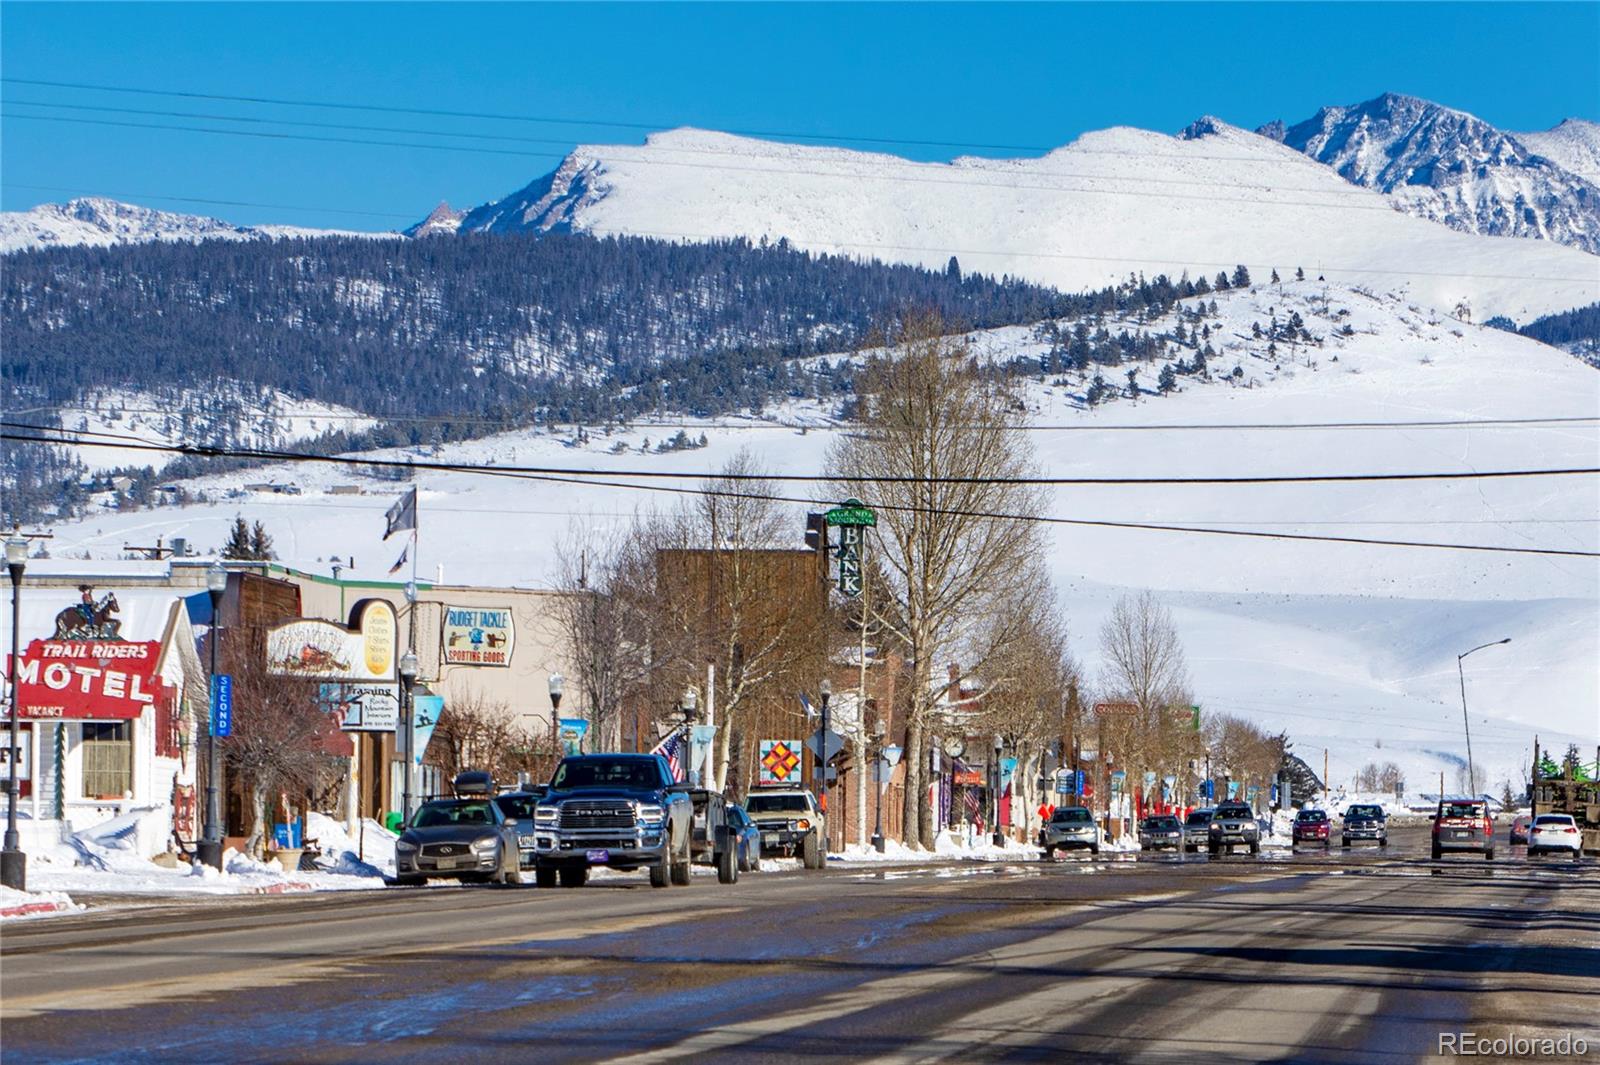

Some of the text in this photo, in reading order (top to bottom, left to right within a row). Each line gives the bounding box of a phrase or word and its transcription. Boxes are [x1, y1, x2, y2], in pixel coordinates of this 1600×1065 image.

[843, 527, 860, 591] BANK
[449, 611, 507, 628] BUDGET TACKLE
[43, 644, 148, 659] TRAIL RIDERS
[449, 650, 505, 662] SPORTING GOODS
[17, 657, 153, 702] MOTEL
[27, 705, 64, 716] VACANCY
[220, 676, 228, 728] SECOND
